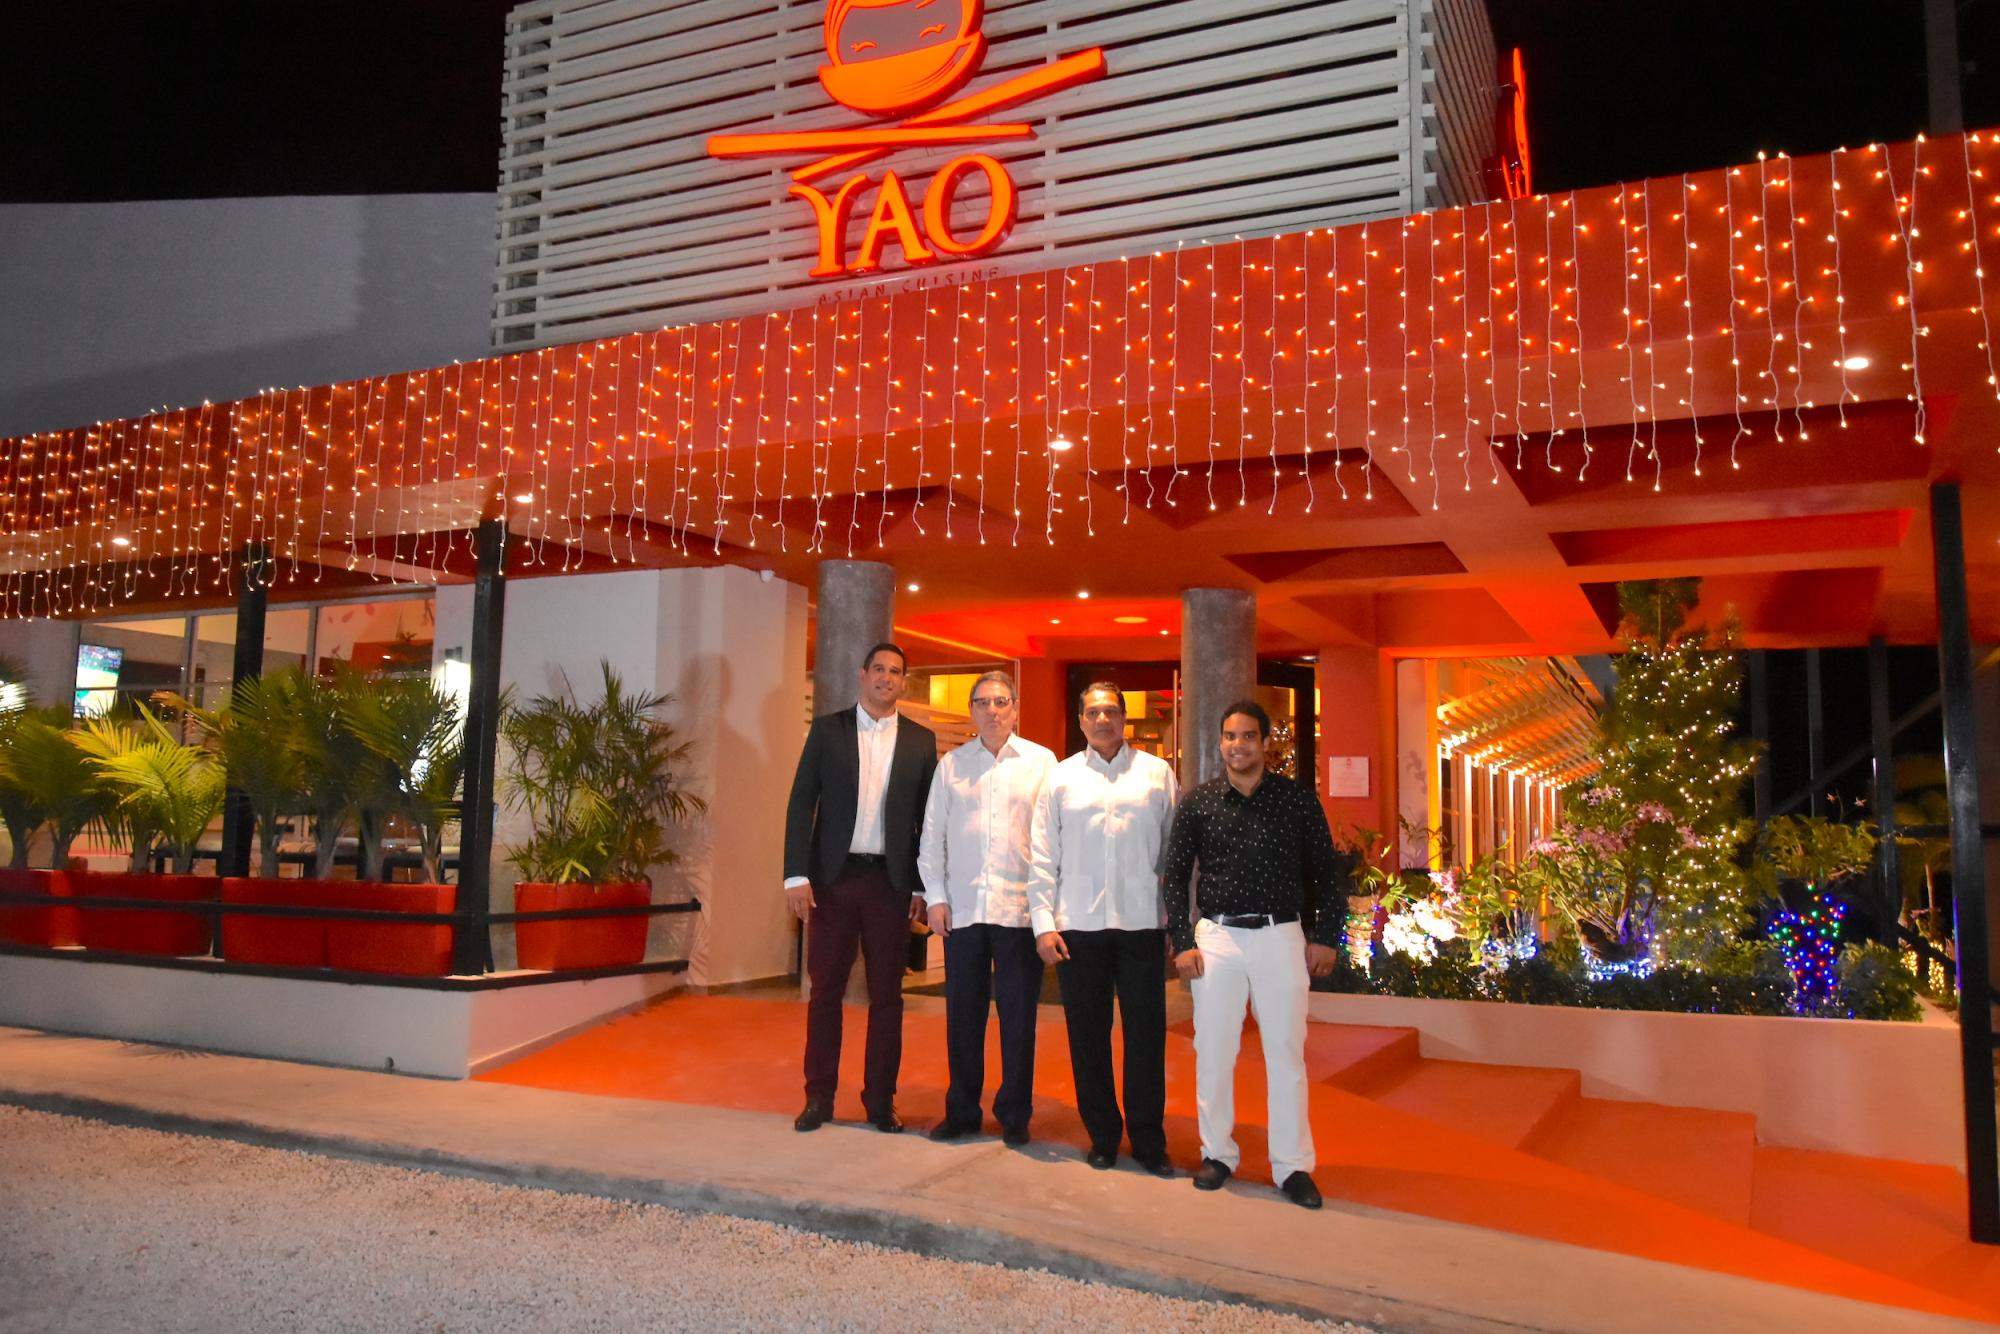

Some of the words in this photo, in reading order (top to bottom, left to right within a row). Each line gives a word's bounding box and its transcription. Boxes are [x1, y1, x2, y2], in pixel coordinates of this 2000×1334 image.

[788, 153, 1016, 278] YAO
[818, 284, 886, 305] ASIAN
[902, 266, 999, 293] CUISINE
